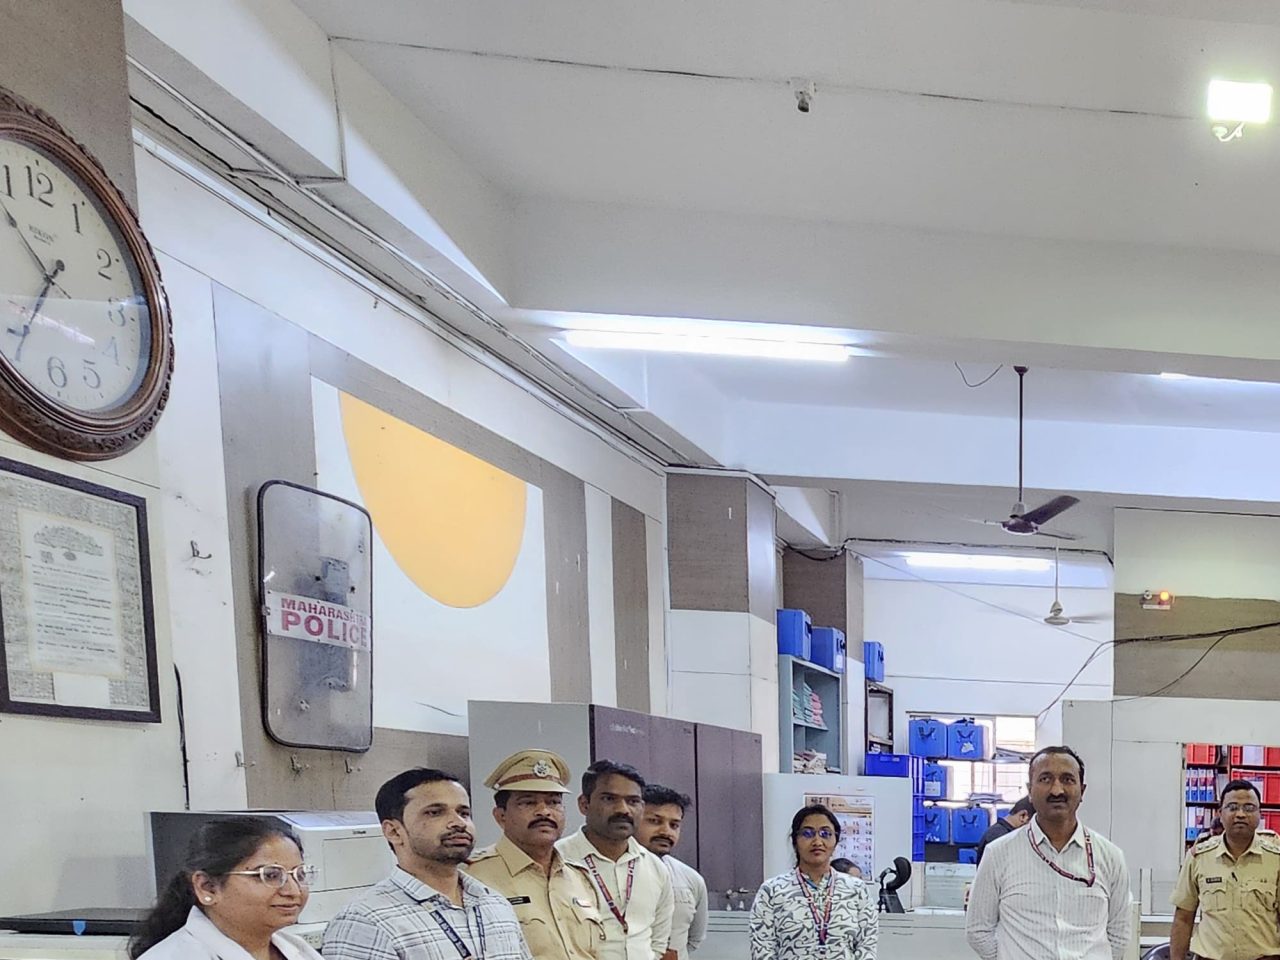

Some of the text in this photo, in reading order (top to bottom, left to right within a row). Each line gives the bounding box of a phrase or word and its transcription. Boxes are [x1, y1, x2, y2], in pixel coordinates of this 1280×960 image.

[24, 165, 54, 207] 12
[72, 203, 84, 234] 1
[97, 248, 112, 280] 2
[108, 297, 126, 327] 3
[47, 356, 67, 388] 6
[83, 359, 100, 388] 5
[281, 610, 367, 647] POLICE
